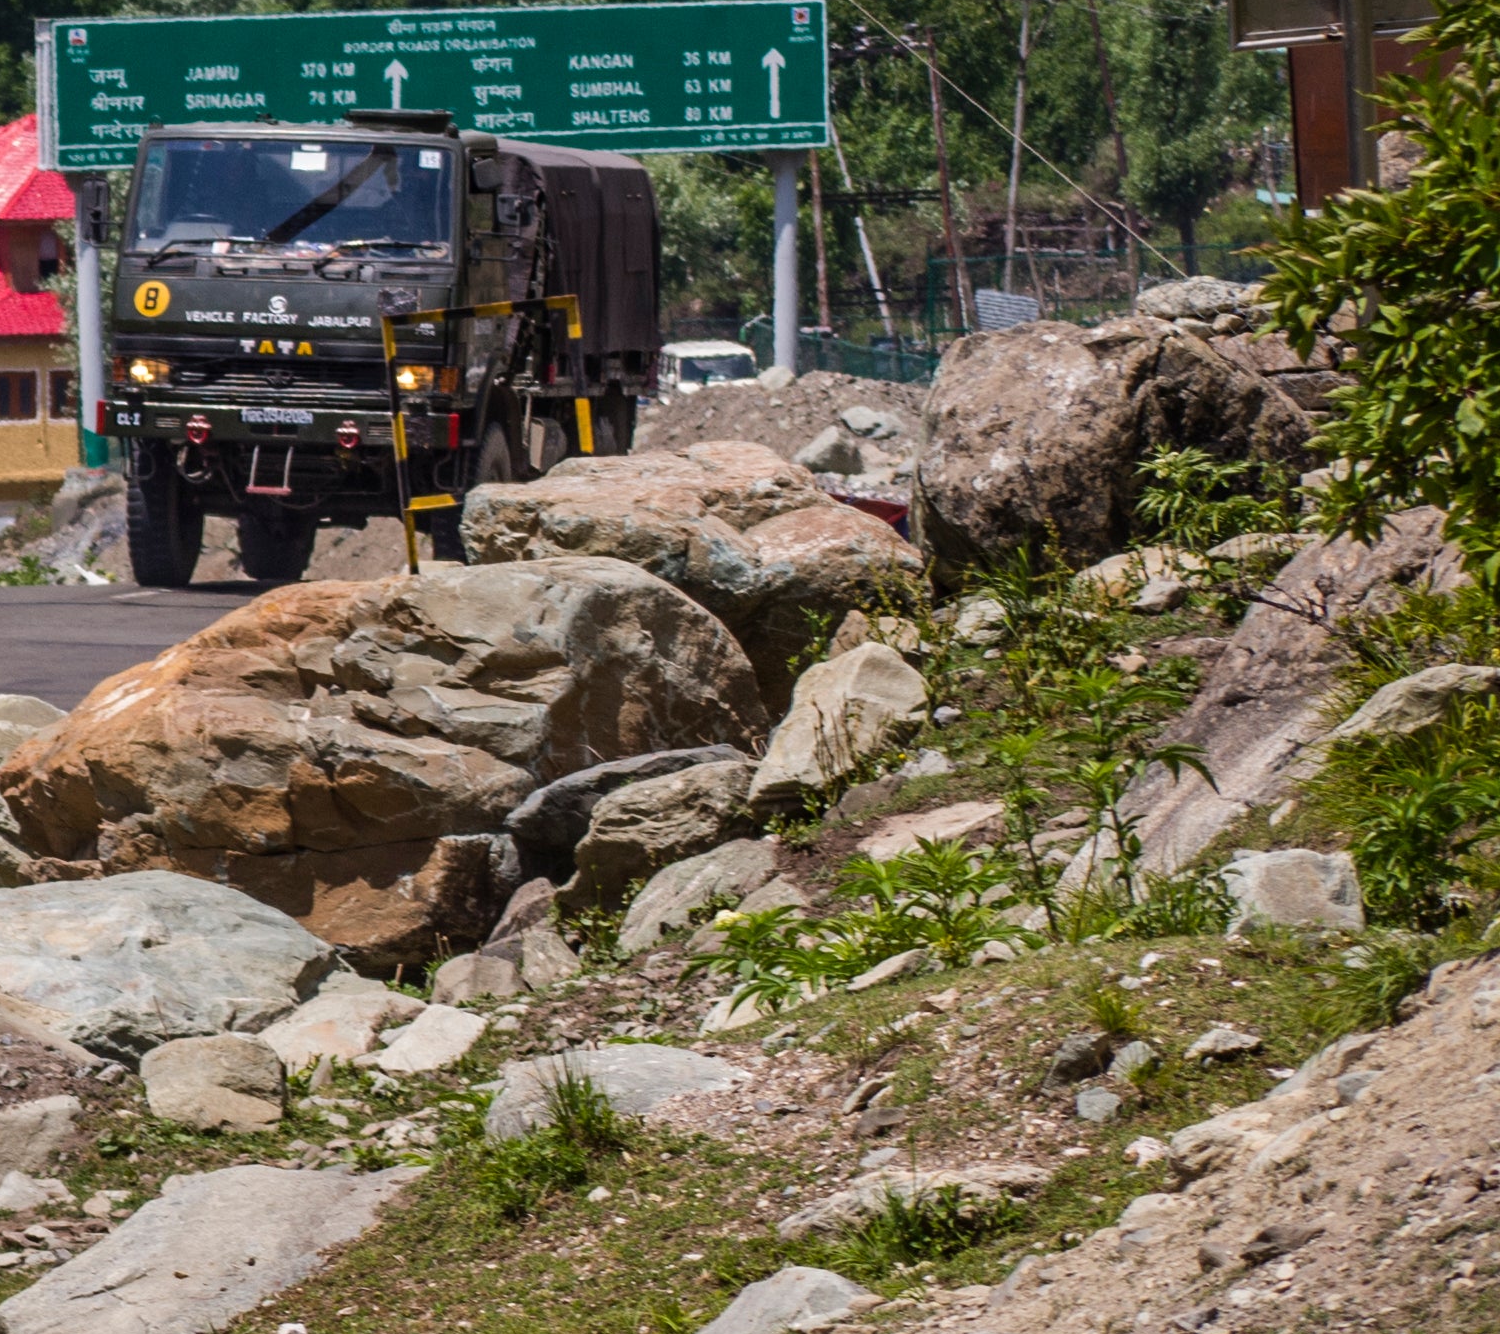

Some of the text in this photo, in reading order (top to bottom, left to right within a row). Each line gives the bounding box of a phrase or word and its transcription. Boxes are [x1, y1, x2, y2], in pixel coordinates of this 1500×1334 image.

[343, 37, 536, 53] BORDER ROADS ORGANISATION
[569, 54, 634, 70] KANGAN
[707, 51, 732, 65] KM
[88, 69, 128, 89] जम्मू
[185, 65, 240, 82] JAMMU
[333, 62, 356, 77] KM
[570, 81, 644, 98] SUMBHAL
[684, 79, 701, 93] 63
[708, 79, 732, 93] KM
[91, 92, 145, 111] श्रीनगर
[186, 93, 266, 110] SRINAGAR
[333, 90, 356, 105] KM
[571, 109, 650, 125] SHALTENG
[709, 106, 733, 120] KM
[143, 287, 159, 310] 8
[185, 310, 371, 327] VEHICLE FACTORY JABALPUR
[240, 338, 314, 355] TATA
